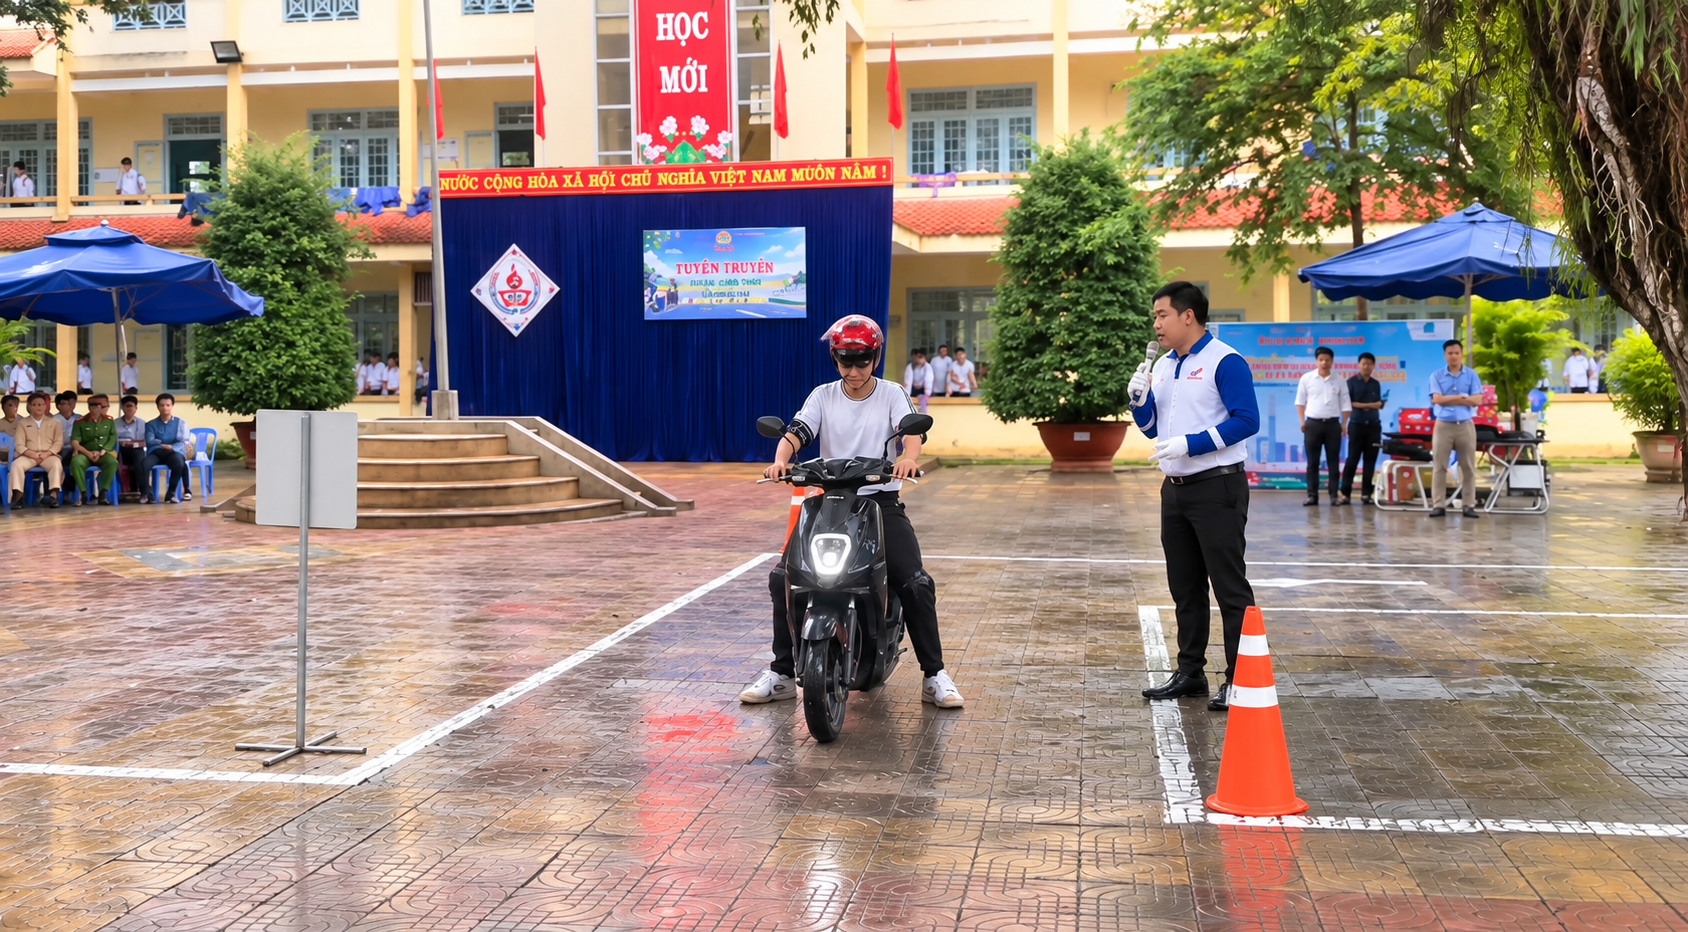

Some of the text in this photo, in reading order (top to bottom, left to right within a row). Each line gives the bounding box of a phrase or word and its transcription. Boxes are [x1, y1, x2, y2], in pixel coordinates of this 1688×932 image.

[656, 11, 709, 47] HỌC
[709, 166, 746, 187] VIỆT
[752, 168, 786, 184] NAM
[881, 165, 888, 179] !
